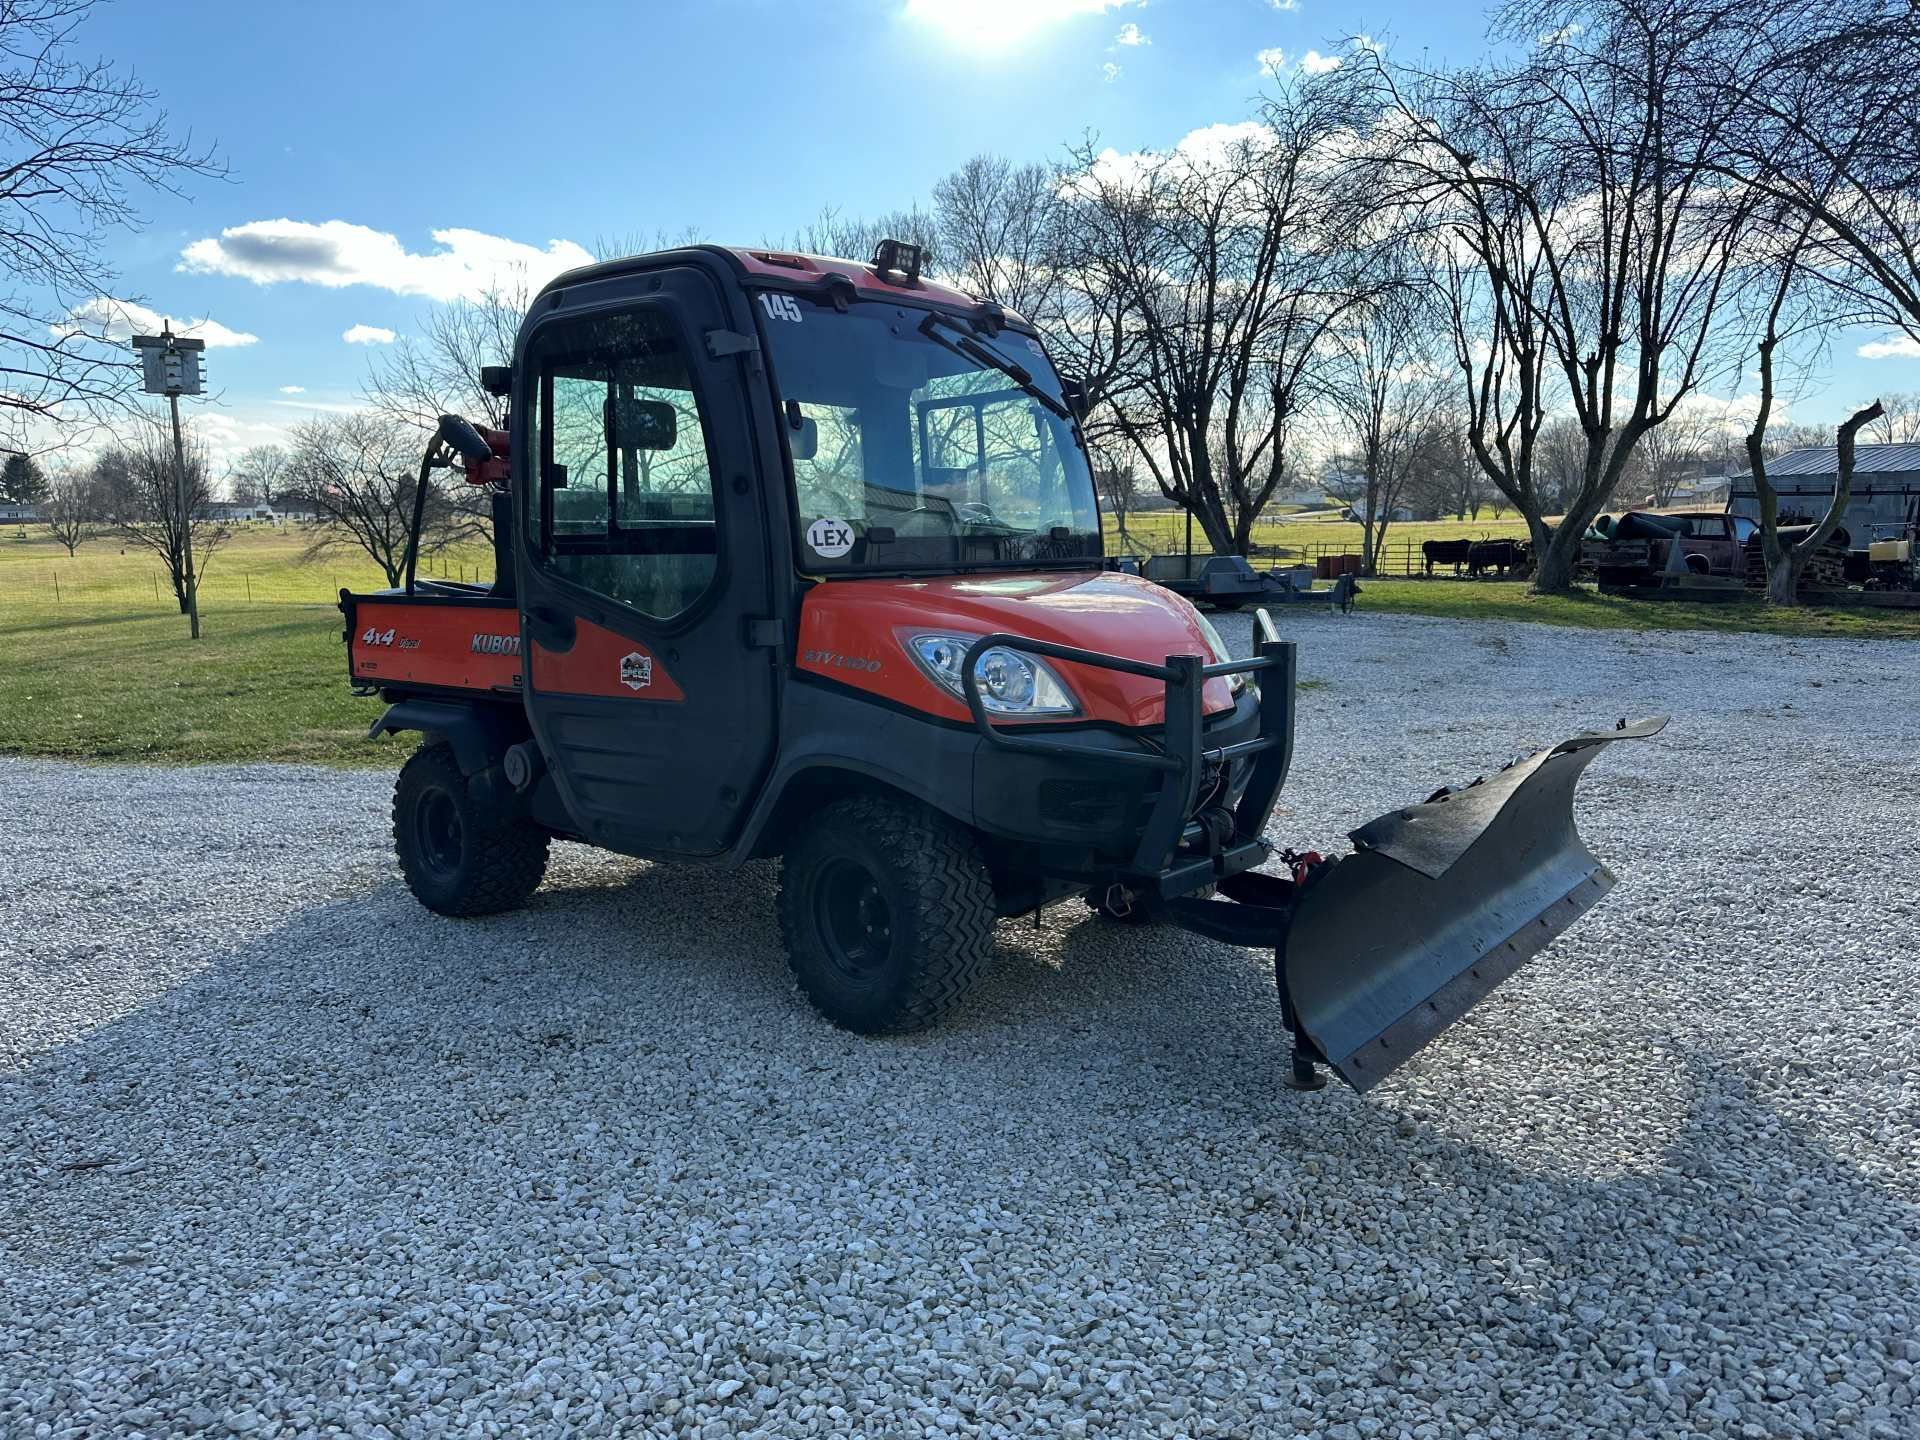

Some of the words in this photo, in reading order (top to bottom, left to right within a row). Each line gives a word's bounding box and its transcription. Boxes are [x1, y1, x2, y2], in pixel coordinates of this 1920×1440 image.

[758, 293, 802, 323] 145
[813, 529, 849, 546] LEX
[362, 627, 396, 647] 4x4
[471, 633, 521, 656] KUBOT
